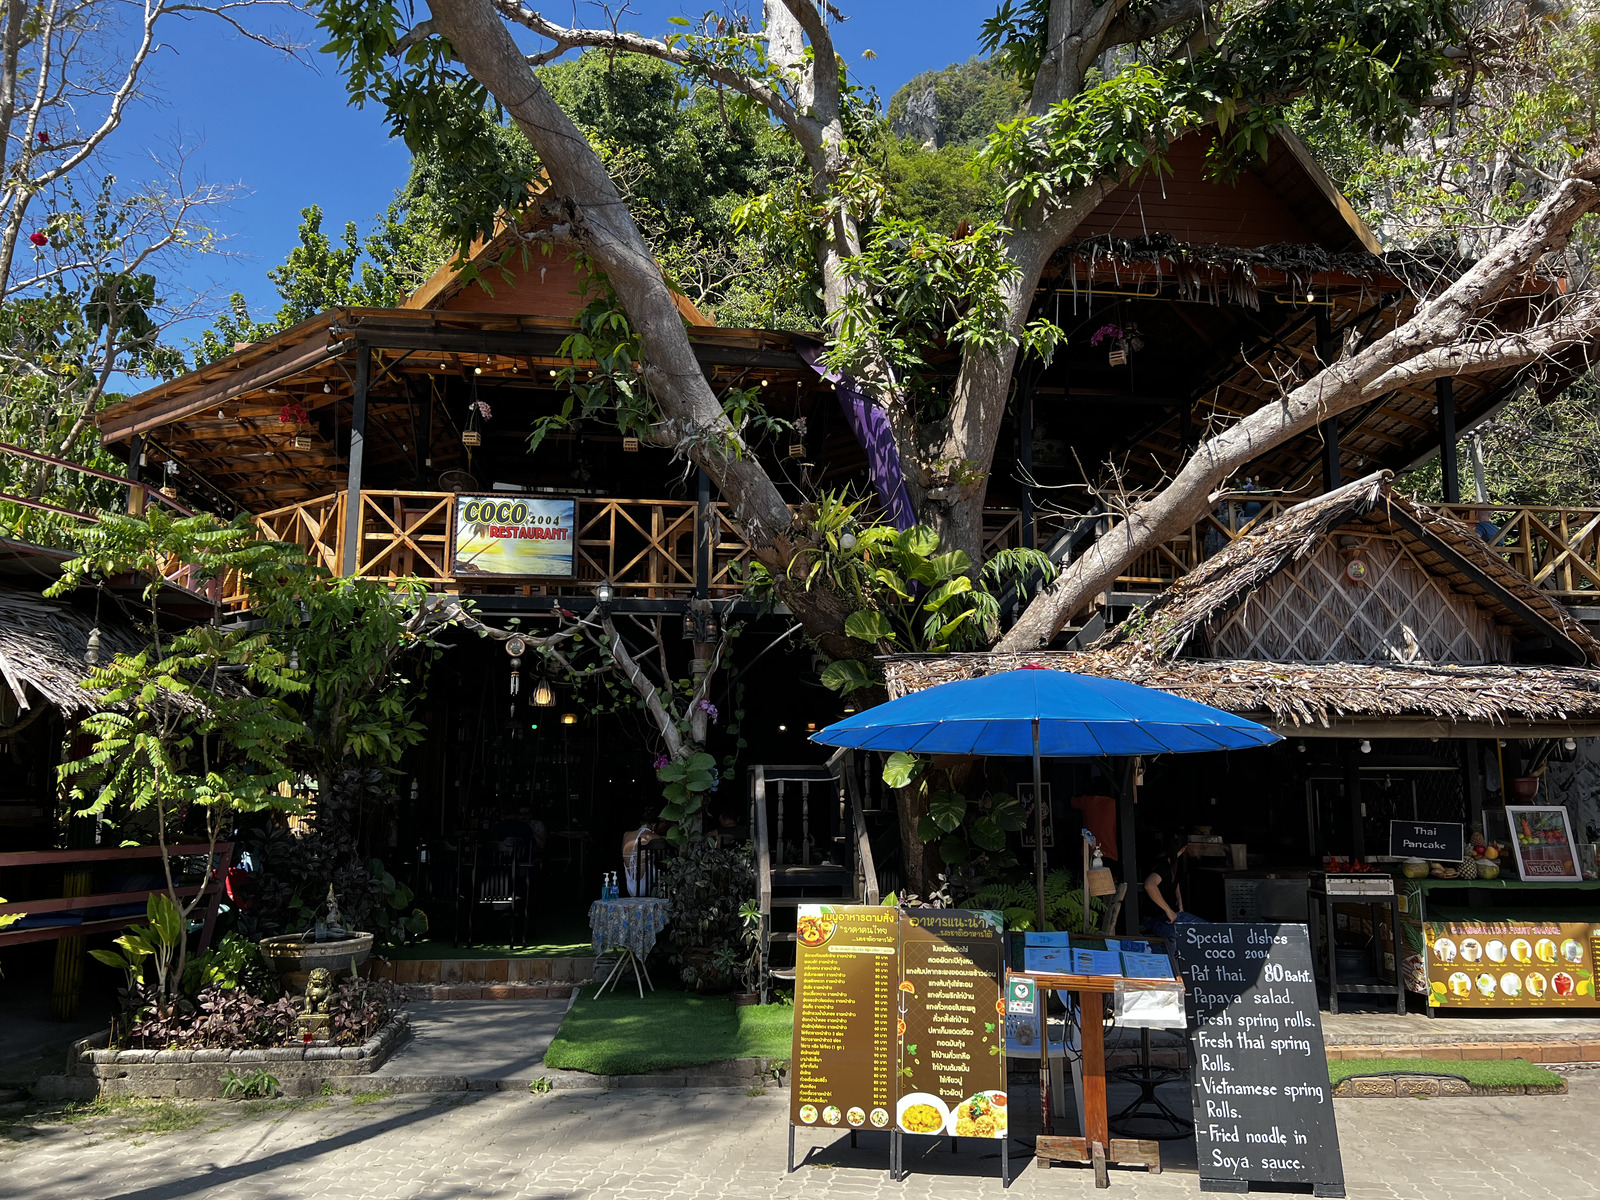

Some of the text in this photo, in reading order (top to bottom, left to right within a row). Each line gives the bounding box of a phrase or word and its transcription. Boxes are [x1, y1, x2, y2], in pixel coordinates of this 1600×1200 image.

[464, 500, 560, 526] COCO 2004
[490, 526, 568, 540] RESTAURANT
[1414, 826, 1437, 836] Thai
[1403, 839, 1447, 850] Pancake
[823, 910, 894, 924] เมนูอาหารตามสั่ง
[910, 914, 985, 928] อาหารแนะนำ
[1186, 928, 1288, 949] Special dishes
[1245, 950, 1270, 959] 2004
[1216, 965, 1246, 982] thai.
[1264, 963, 1284, 982] 80
[1285, 969, 1312, 983] Baht.
[1253, 988, 1294, 1004] salad.
[1238, 1014, 1279, 1033] spring
[1284, 1011, 1316, 1027] rolls.
[1236, 1032, 1265, 1050] thai
[1271, 1038, 1311, 1056] spring
[1202, 1054, 1235, 1072] Rolls.
[1284, 1084, 1323, 1103] spring
[1206, 1100, 1241, 1119] Rolls.
[1246, 1126, 1287, 1145] noodle
[1293, 1131, 1307, 1145] in
[1212, 1149, 1305, 1175] Soya sauce.
